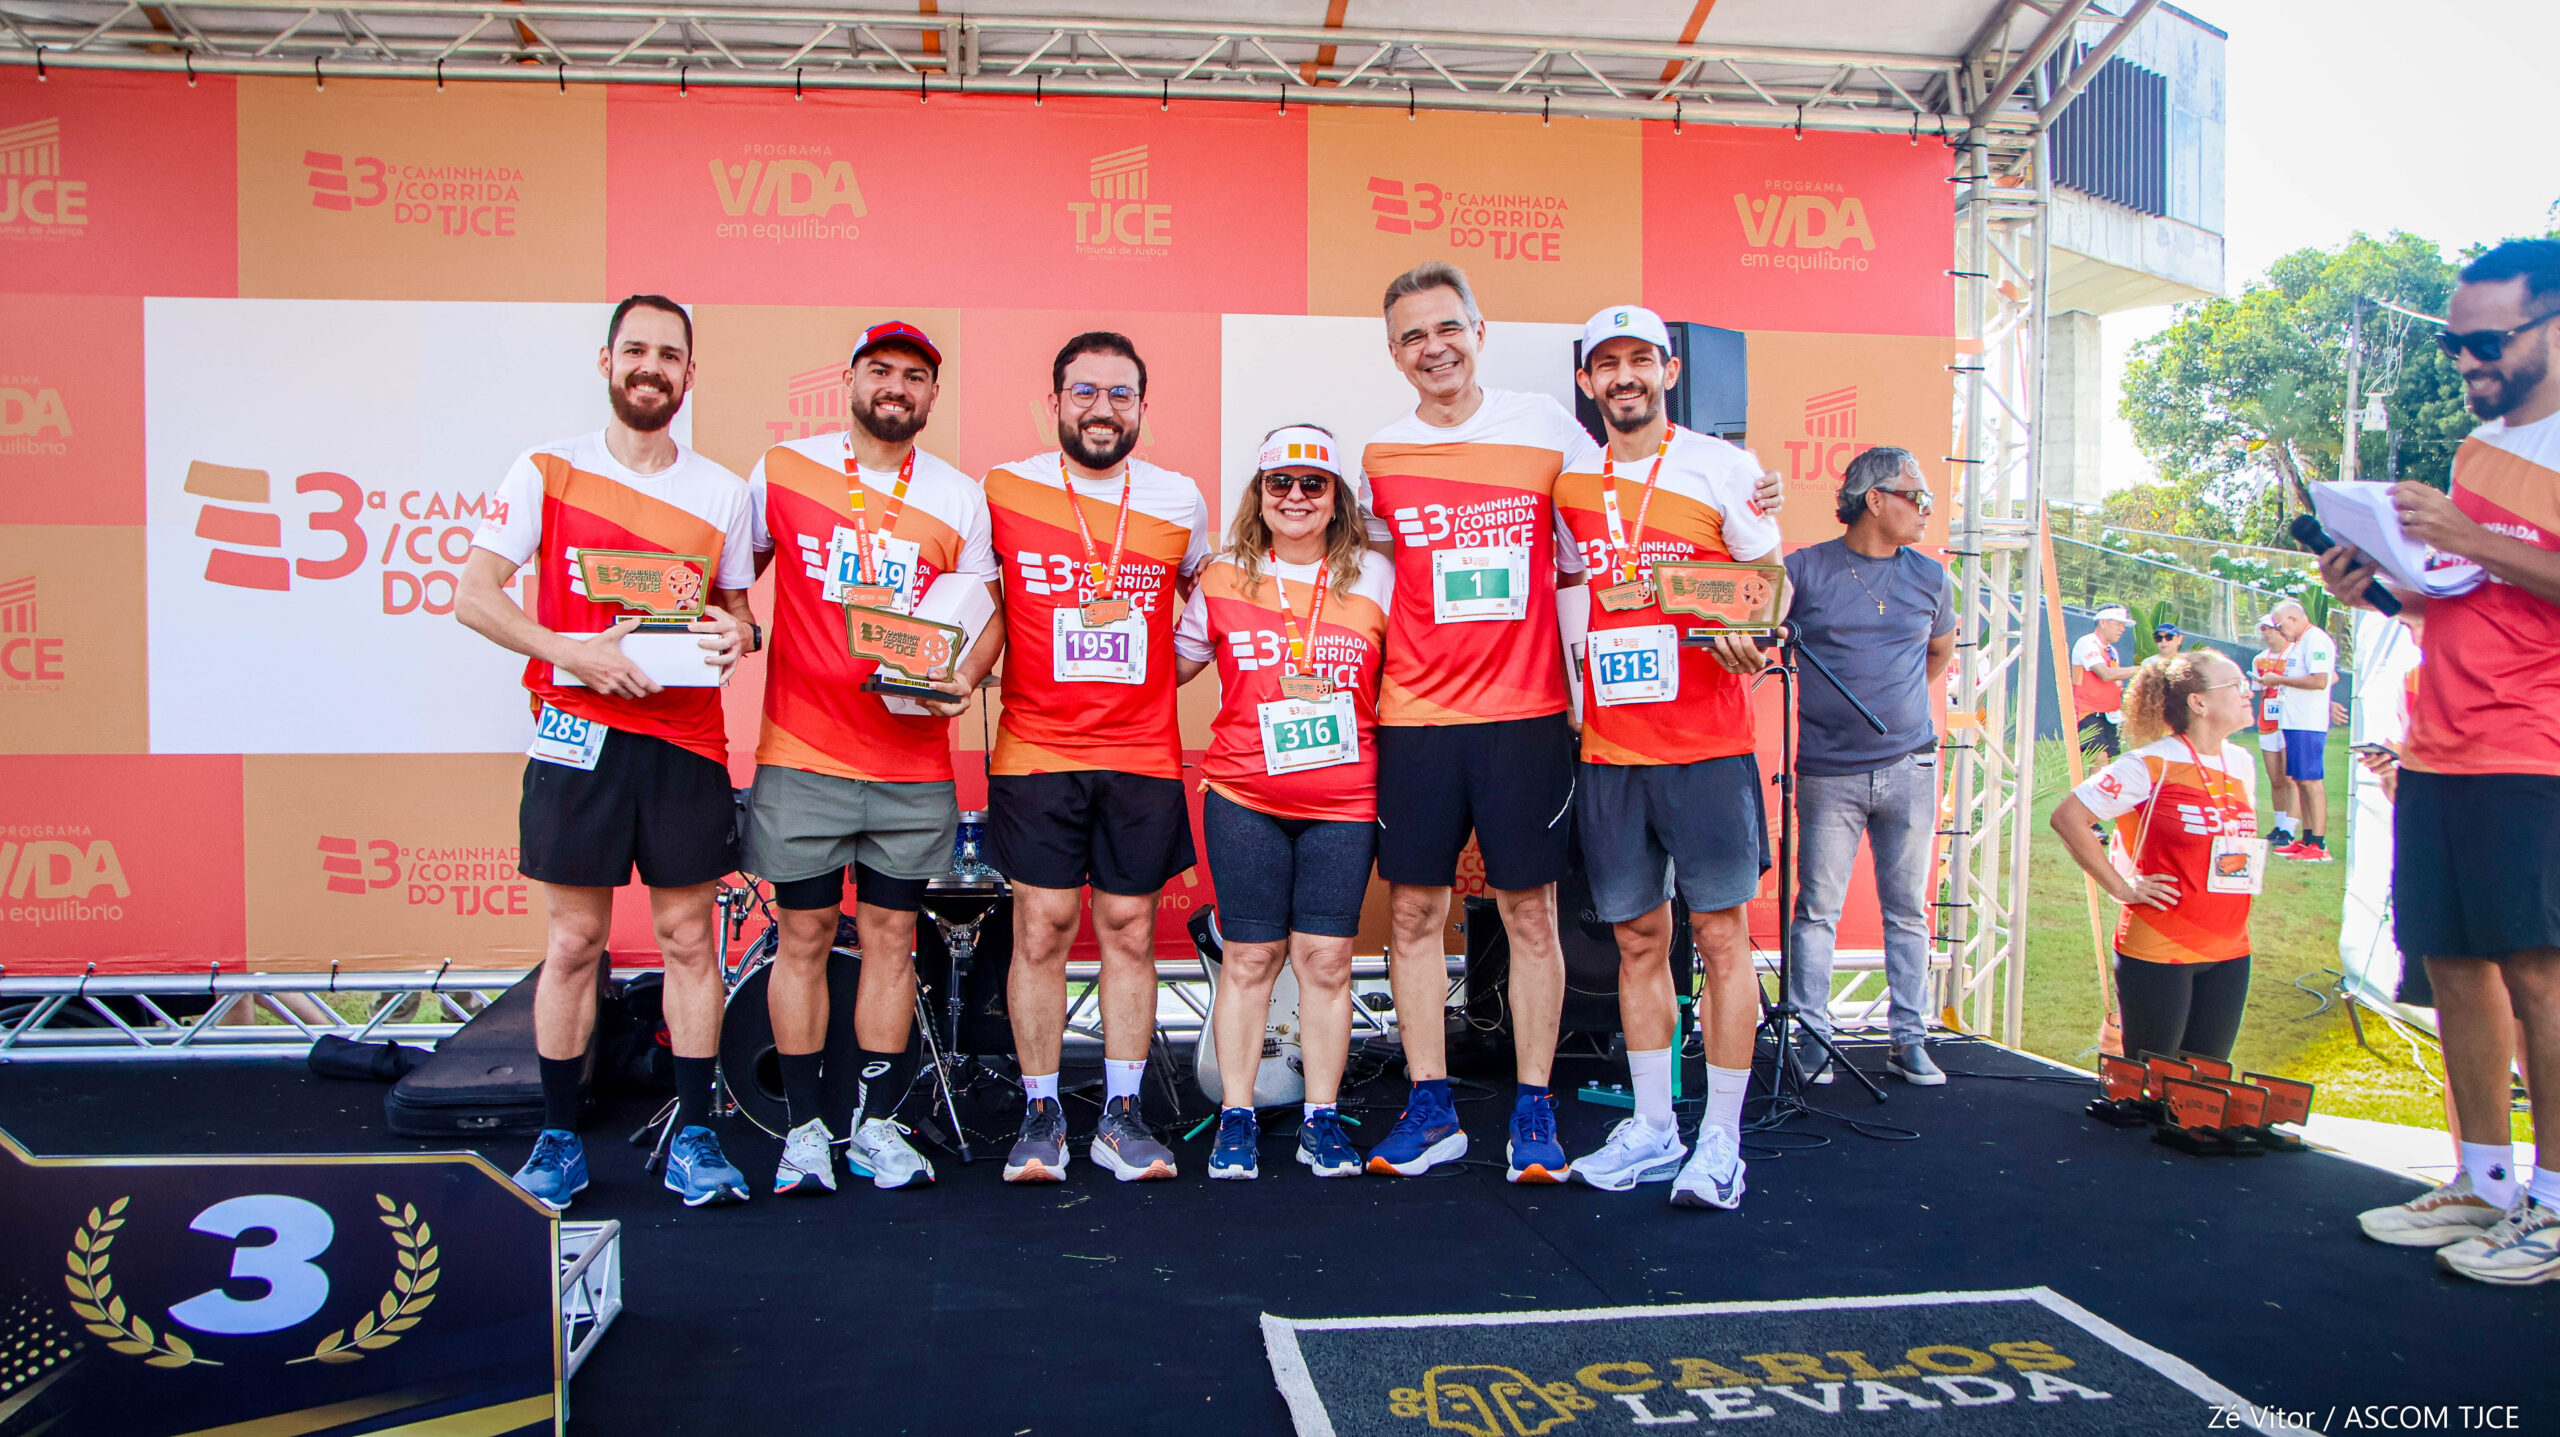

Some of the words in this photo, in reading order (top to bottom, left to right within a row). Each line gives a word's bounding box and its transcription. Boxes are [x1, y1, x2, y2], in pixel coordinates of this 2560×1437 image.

[744, 144, 832, 156] PROGRAMA
[402, 165, 524, 182] CAMINHADA
[708, 159, 867, 217] VIDA
[1765, 180, 1844, 193] PROGRAMA
[0, 179, 88, 224] JCE
[1458, 192, 1568, 210] CAMINHADA
[394, 202, 432, 224] DO
[436, 205, 516, 237] TJCE
[716, 223, 747, 238] em
[753, 218, 860, 244] equilíbrio
[1067, 202, 1172, 246] TJCE
[1733, 193, 1875, 251] VIDA
[1075, 245, 1116, 255] Tribunal
[1450, 228, 1485, 248] DO
[1489, 231, 1561, 261] TJCE
[1741, 253, 1769, 267] em
[1773, 251, 1869, 274] equilíbrio
[0, 388, 74, 437] DA
[1784, 440, 1878, 481] TJC
[1457, 495, 1539, 516] CAMINHADA
[1455, 531, 1481, 548] DO
[1482, 523, 1534, 548] TJCE
[383, 570, 458, 615] DO
[1470, 571, 1482, 597] 1
[1, 637, 65, 681] CE
[1068, 633, 1126, 660] 1951
[1601, 651, 1658, 682] 1313
[1283, 718, 1331, 749] 316
[415, 847, 521, 861] CAMINHAD
[10, 900, 123, 927] equilíbrio
[408, 884, 445, 905] DO
[450, 885, 528, 916] TJCE
[168, 1194, 335, 1335] 3
[1575, 1340, 2077, 1394] CARLOS
[1612, 1370, 2113, 1424] LEVADA
